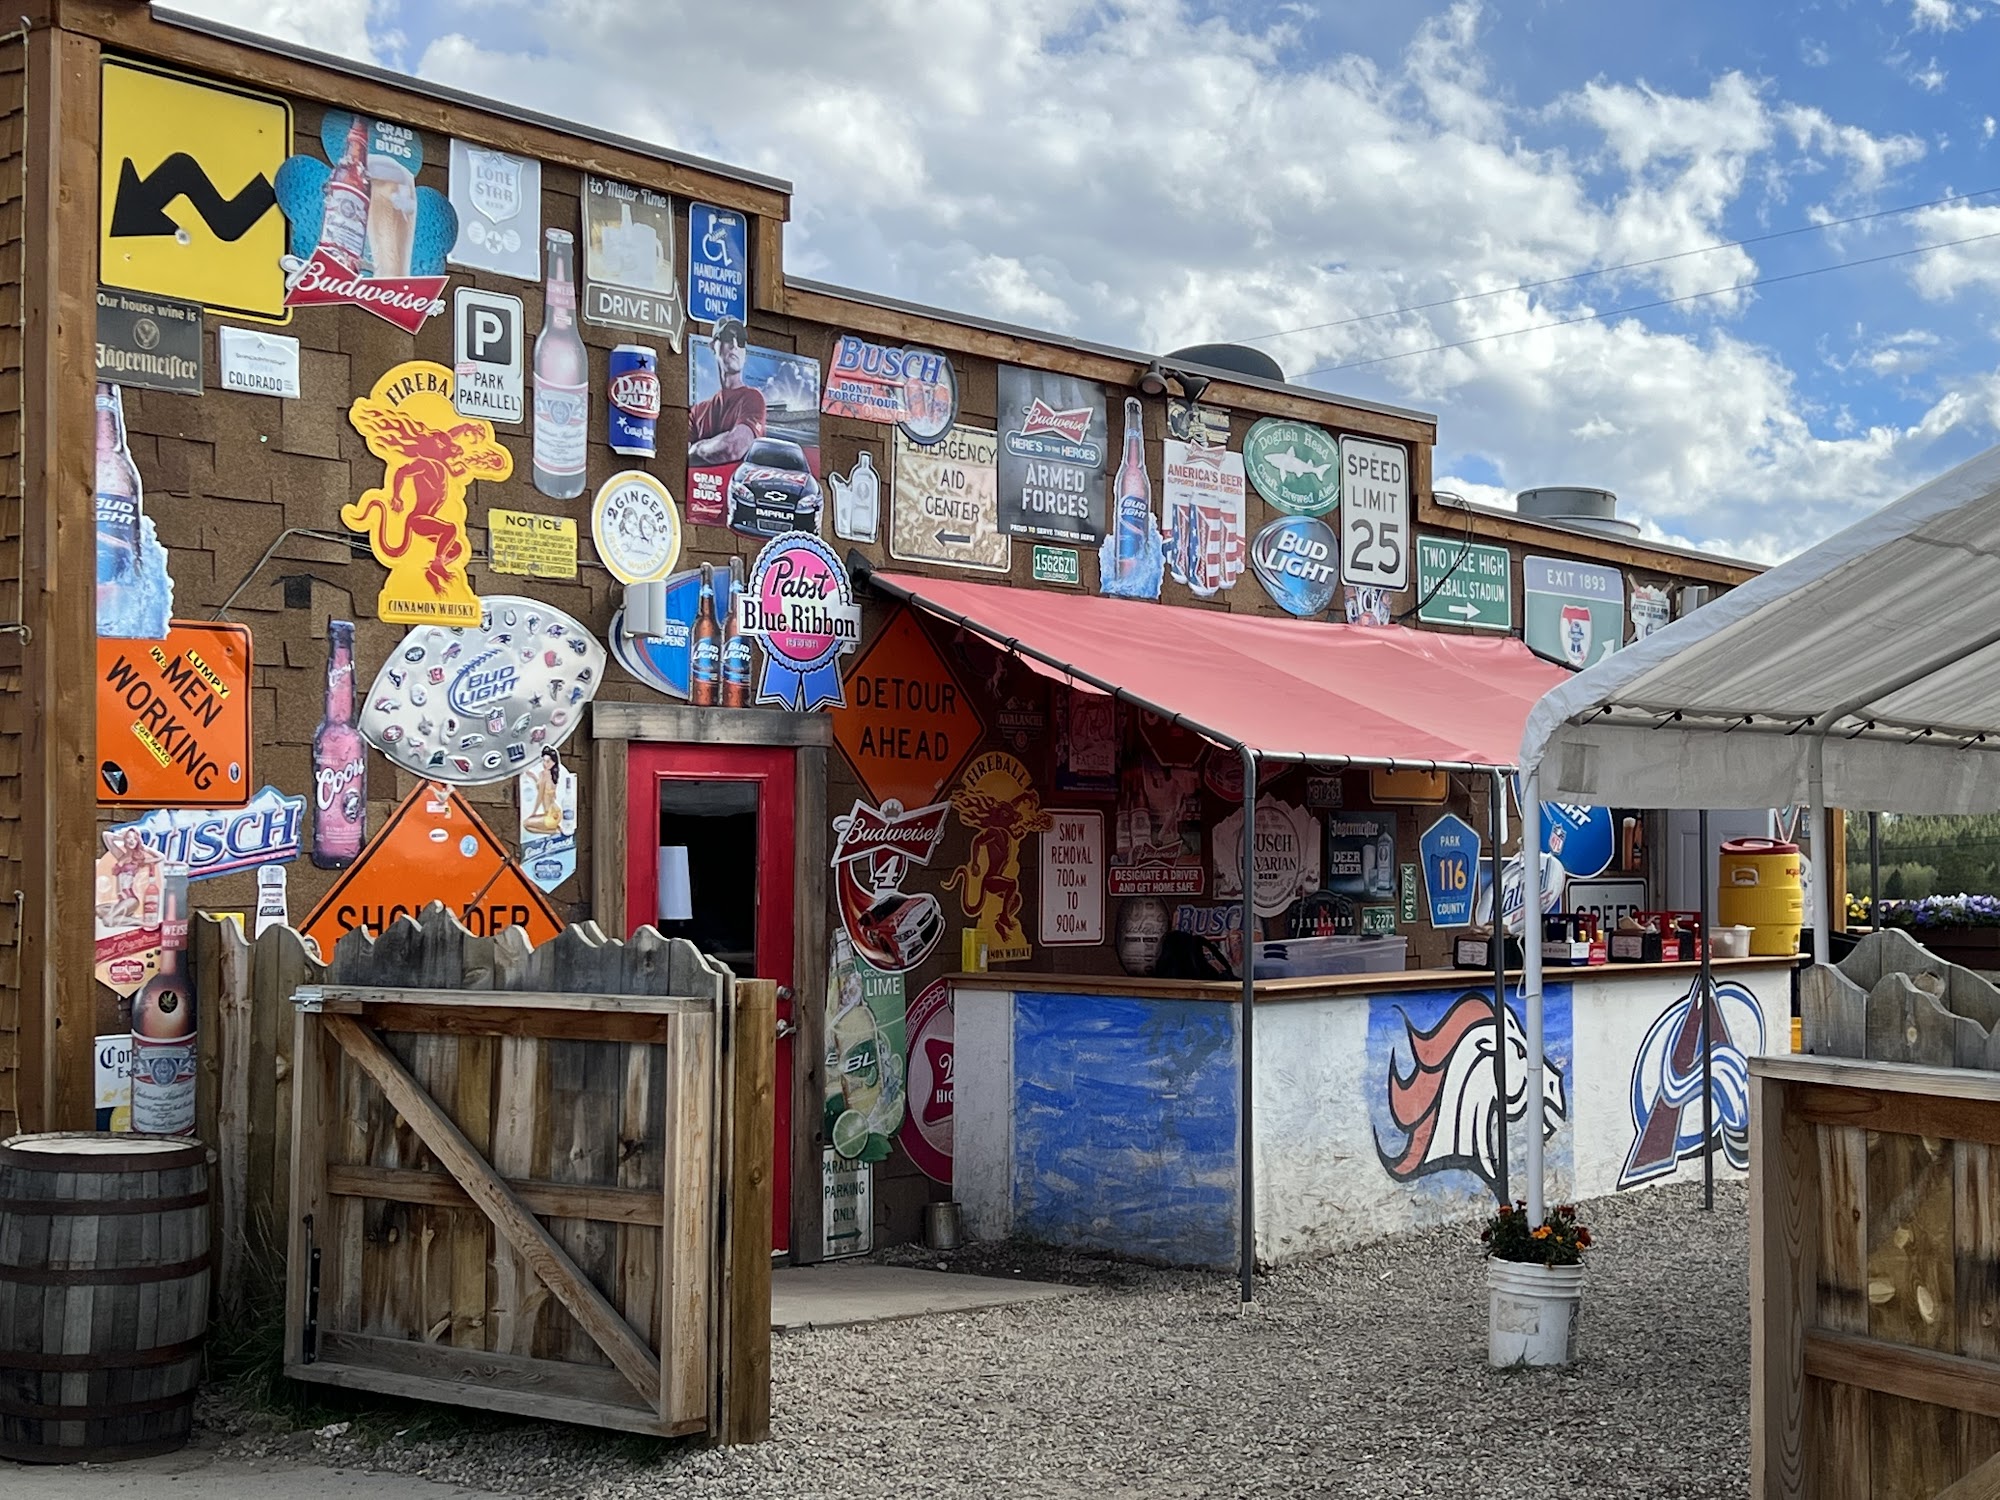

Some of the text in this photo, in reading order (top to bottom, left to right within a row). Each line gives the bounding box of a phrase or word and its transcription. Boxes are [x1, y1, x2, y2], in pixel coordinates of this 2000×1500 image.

[375, 121, 413, 141] GRAB
[375, 139, 411, 158] BUDS
[475, 183, 513, 202] STAR
[589, 178, 666, 209] to Miller Time
[693, 261, 742, 286] HANDICAPPED
[279, 254, 446, 318] Budweiser
[698, 279, 737, 301] PARKING
[97, 292, 197, 322] Our house wine is
[600, 292, 650, 320] DRIVE
[655, 303, 672, 325] IN
[705, 297, 728, 315] ONLY
[475, 310, 504, 356] P
[837, 336, 945, 385] BUSCH
[229, 370, 283, 392] COLORADO
[385, 372, 455, 408] FIREBA
[474, 371, 504, 390] PARK
[841, 382, 873, 396] DON'T
[460, 388, 518, 411] PARALLEL
[828, 389, 899, 410] FORGET YOUR
[1022, 405, 1091, 431] Budweiser
[1011, 437, 1044, 453] HERE'S
[1061, 444, 1097, 462] HEROES
[1258, 429, 1330, 461] Dogfish Head
[693, 472, 723, 486] GRAB
[940, 469, 965, 490] AID
[1026, 463, 1086, 493] ARMED
[1167, 463, 1243, 487] AMERICA'S BEER
[1348, 454, 1401, 484] SPEED
[693, 488, 723, 502] BUDS
[1257, 463, 1336, 504] Craft Brewed Ales
[925, 496, 981, 522] CENTER
[1022, 488, 1090, 518] FORCES
[1124, 500, 1147, 510] BUD
[1352, 485, 1398, 514] LIMIT
[506, 515, 562, 531] NOTICE
[755, 508, 795, 521] IMPALA
[1277, 530, 1328, 560] BUD
[1350, 518, 1401, 574] 25
[1265, 548, 1335, 584] LIGHT
[1423, 546, 1447, 569] TWO
[1479, 553, 1505, 577] HIGH
[771, 556, 831, 600] Pabst
[1547, 569, 1606, 592] EXIT 1893
[1469, 581, 1506, 602] STADIUM
[388, 599, 475, 617] CINNAMON WHISKY
[743, 600, 857, 638] Blue Ribbon
[665, 626, 690, 637] TEVER
[693, 650, 719, 661] LIGHT
[697, 642, 719, 653] BUD
[723, 650, 751, 661] LIGHT
[728, 641, 750, 653] BUD
[186, 650, 229, 695] LUMPY
[468, 666, 515, 688] BUD
[161, 655, 223, 729] MEN
[460, 676, 520, 705] LIGHT
[855, 675, 957, 715] DETOUR
[106, 655, 219, 791] WORKING
[150, 738, 171, 764] MAYO
[858, 725, 950, 762] AHEAD
[966, 755, 1027, 790] FIREBALL
[316, 758, 365, 811] Coors
[833, 816, 945, 845] Budweiser
[1059, 823, 1085, 842] SNOW
[1440, 835, 1461, 848] PARK
[1254, 833, 1292, 852] USCH
[1051, 846, 1093, 865] REMOVAL
[1241, 856, 1297, 872] VARIAN
[1333, 851, 1361, 864] DEER
[875, 855, 900, 888] 4
[1056, 869, 1088, 887] 700AM
[1115, 869, 1199, 881] DESIGNATE A DRIVER
[1439, 859, 1467, 891] 116
[1118, 882, 1136, 893] AND
[1137, 882, 1152, 893] GET
[1152, 882, 1175, 892] HOME
[1067, 891, 1079, 910] TO
[1437, 903, 1466, 916] COUNTY
[336, 904, 531, 940] SHODER
[1056, 914, 1087, 934] 900AM
[1177, 905, 1243, 935] BUSC
[866, 977, 901, 997] LIME
[100, 1045, 132, 1070] Cor
[844, 1052, 876, 1074] BL
[825, 1181, 865, 1199] PARKING
[833, 1206, 857, 1223] ONLY
